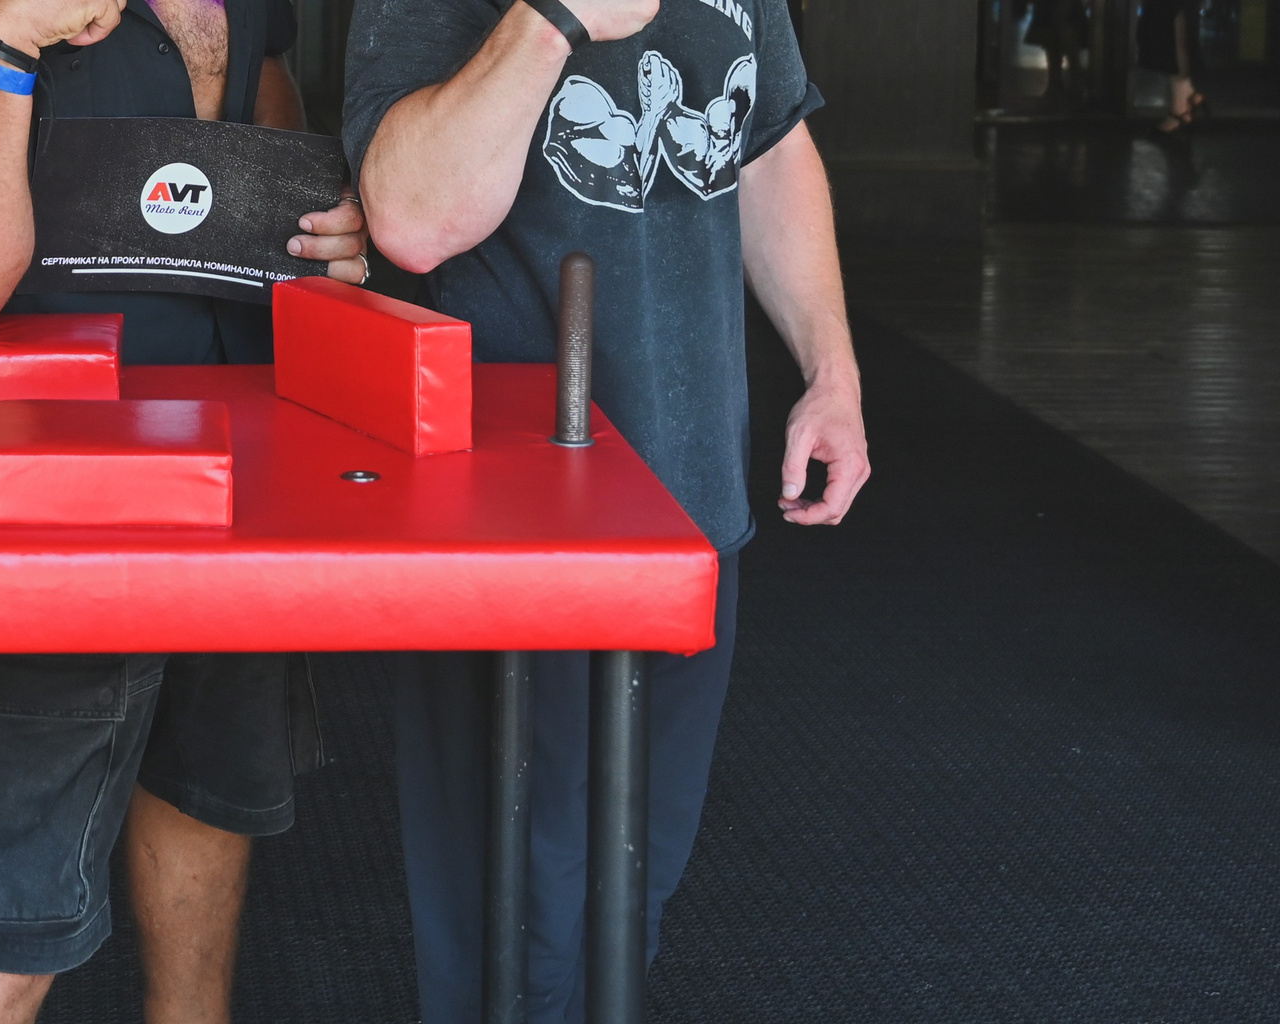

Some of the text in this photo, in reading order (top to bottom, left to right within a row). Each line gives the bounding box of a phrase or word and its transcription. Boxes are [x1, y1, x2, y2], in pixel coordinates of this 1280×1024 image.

[147, 182, 208, 204] AVT
[145, 204, 204, 216] Moto Rent
[41, 257, 97, 266] СЕРТИФИКАТ
[98, 257, 110, 265] НА
[111, 256, 145, 265] ПРОКАТ
[146, 256, 202, 268] МОТОЦИКЛА
[203, 261, 263, 278] НОМИНАЛОМ
